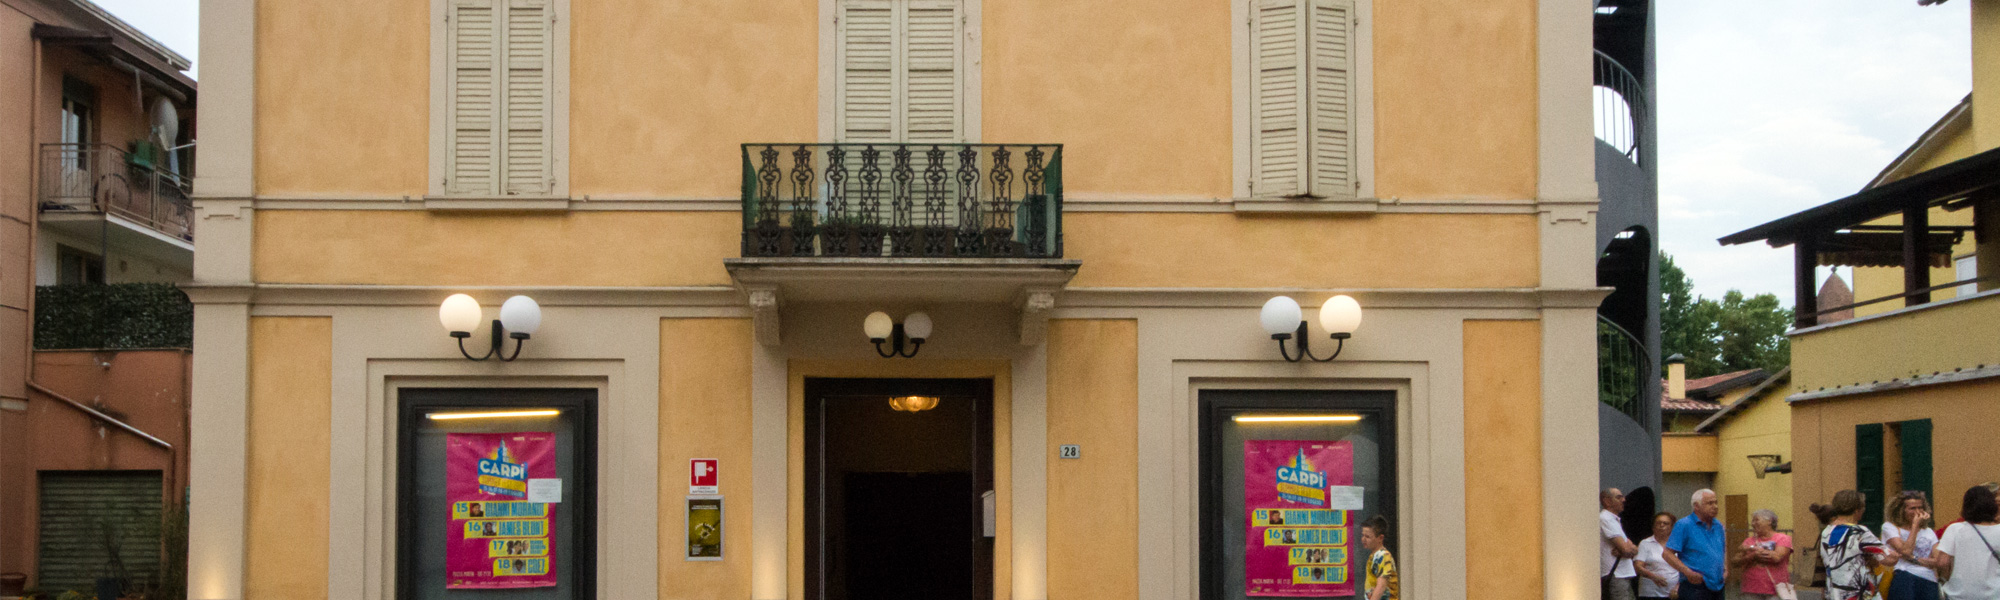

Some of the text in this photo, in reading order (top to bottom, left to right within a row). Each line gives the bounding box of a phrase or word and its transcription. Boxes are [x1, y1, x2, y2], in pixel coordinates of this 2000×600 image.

[1064, 446, 1076, 457] 28
[456, 503, 468, 513] 15
[1255, 510, 1268, 520] 15
[468, 521, 544, 536] 16 JAMES BLUNT
[1268, 529, 1342, 544] 16 JAMES BLUNT
[493, 540, 505, 550] 17
[1292, 548, 1304, 558] 17
[497, 559, 510, 569] 18
[1297, 567, 1310, 577] 18
